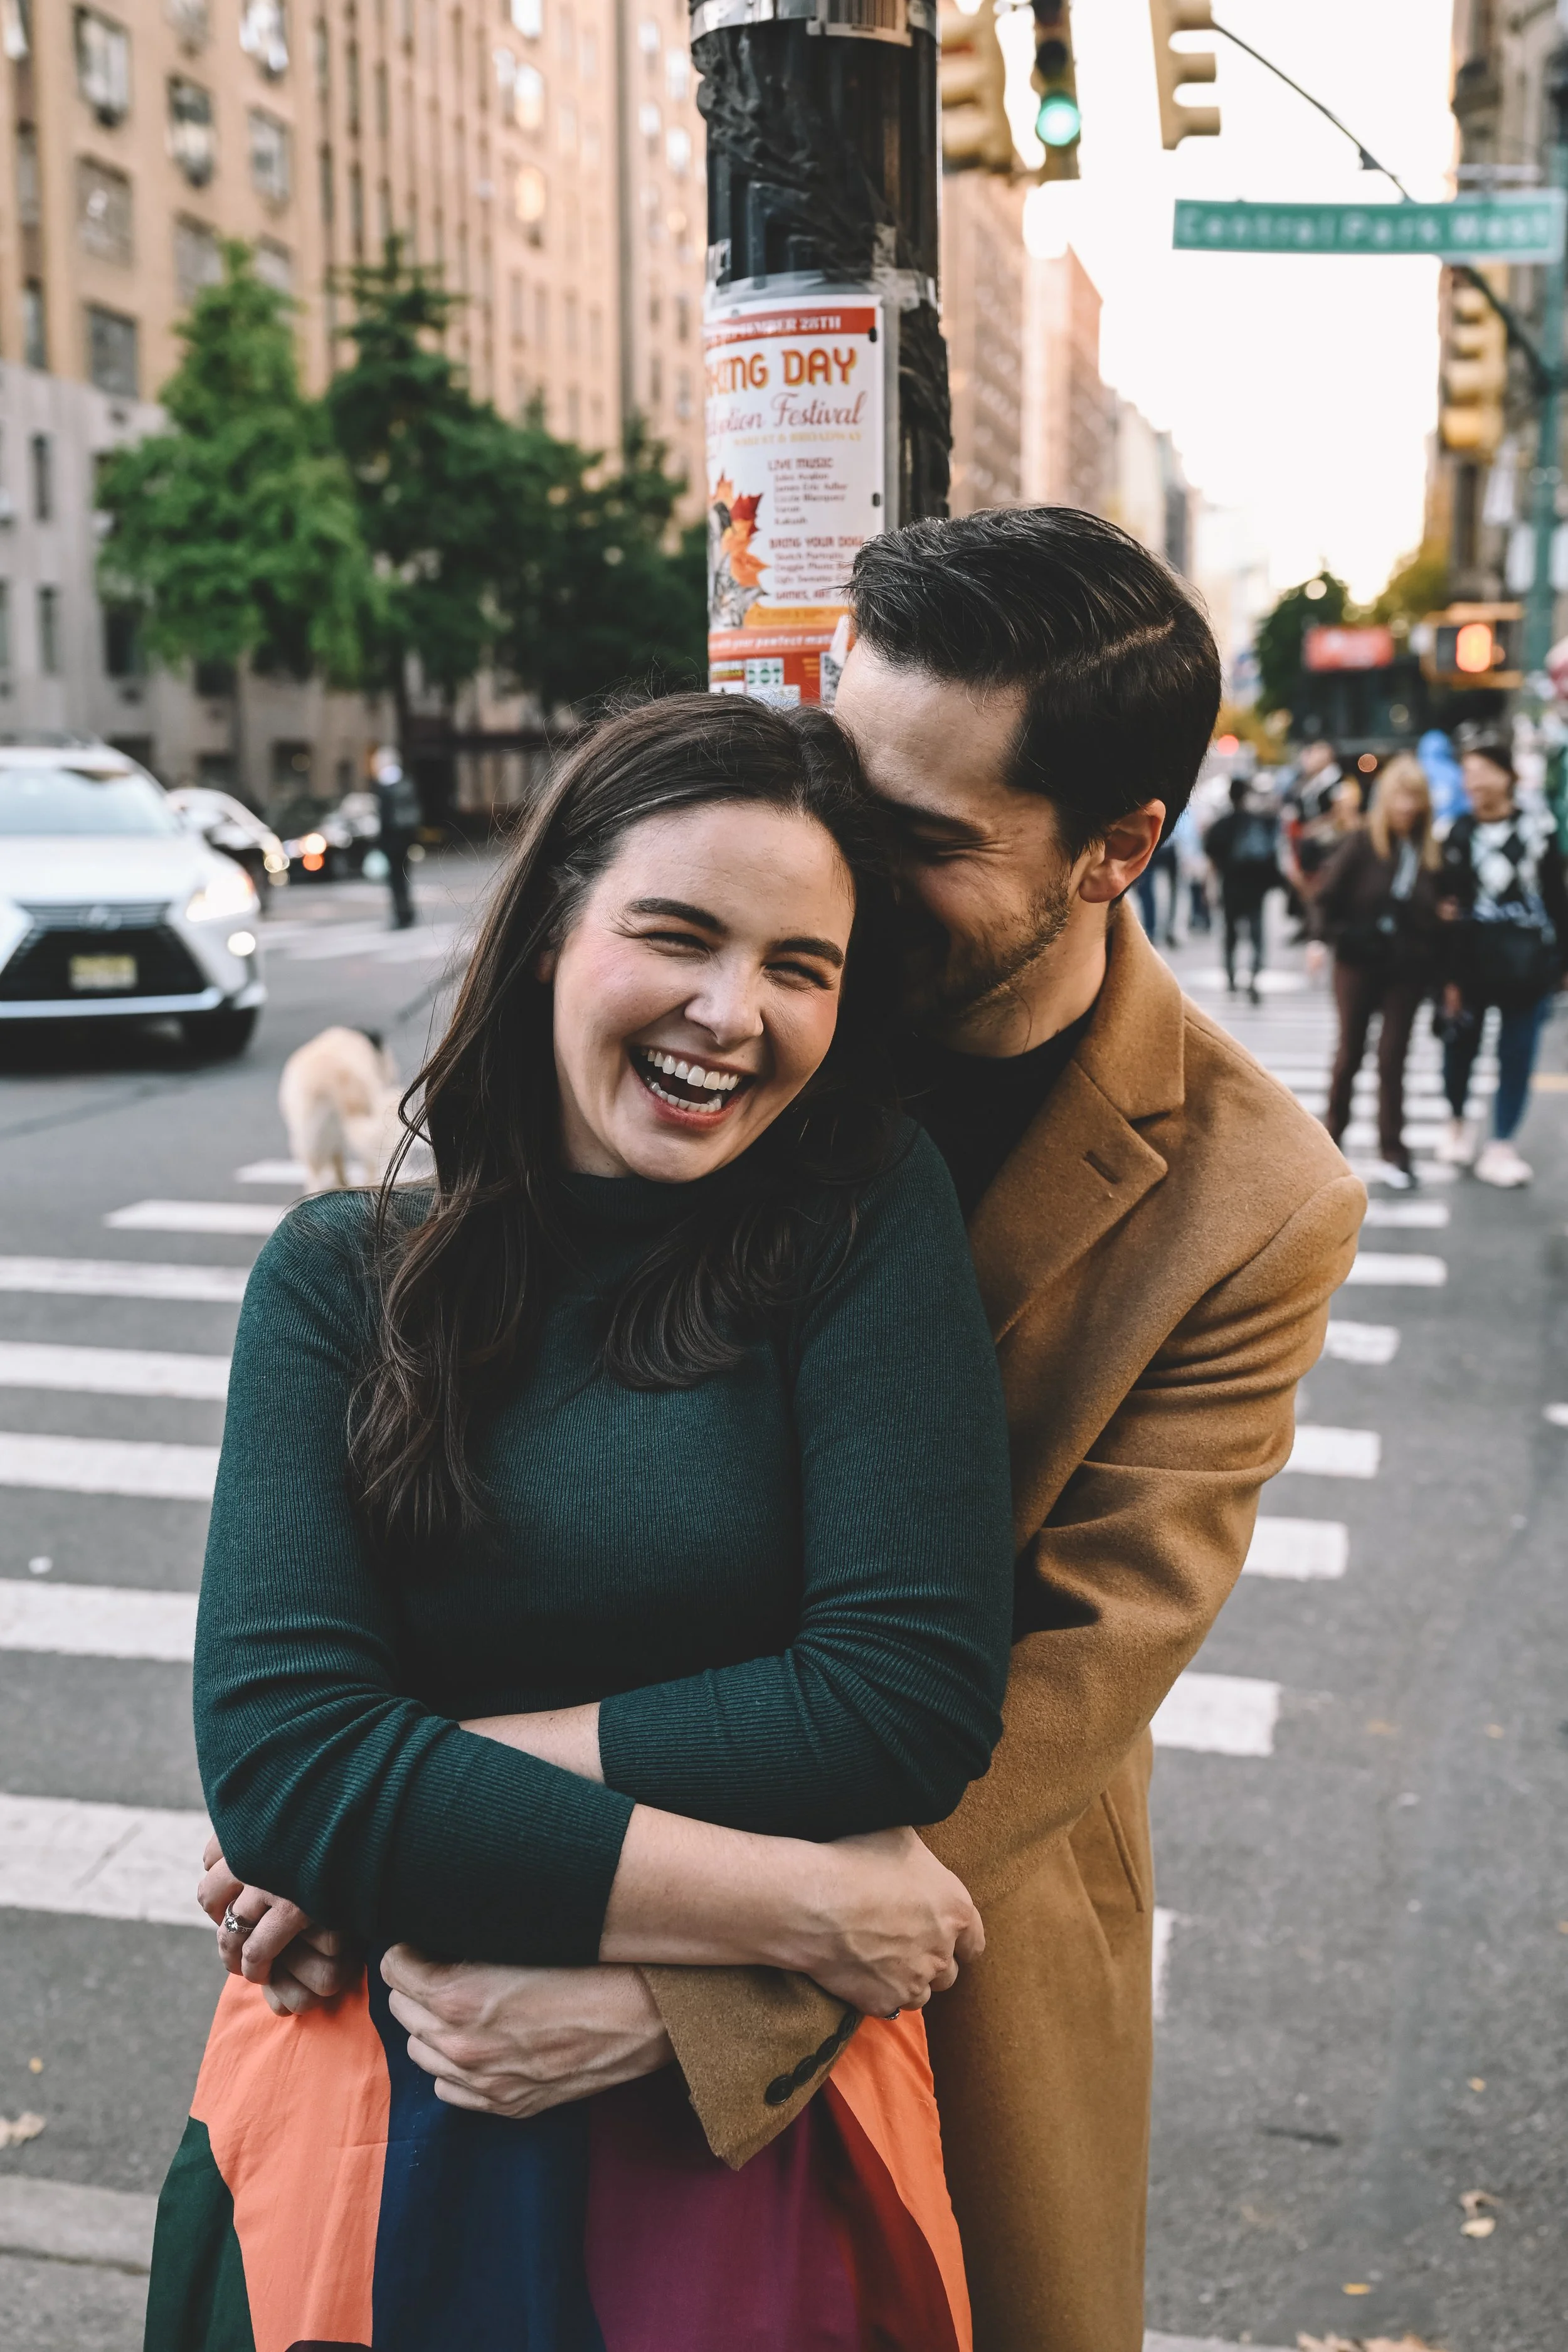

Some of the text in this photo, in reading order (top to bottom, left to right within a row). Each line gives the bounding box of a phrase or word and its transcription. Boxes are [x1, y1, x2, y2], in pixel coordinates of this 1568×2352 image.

[1341, 209, 1443, 245] Park
[1448, 211, 1550, 246] West
[781, 347, 857, 386] DAY
[771, 390, 867, 427] Festival
[805, 535, 834, 547] YOUR
